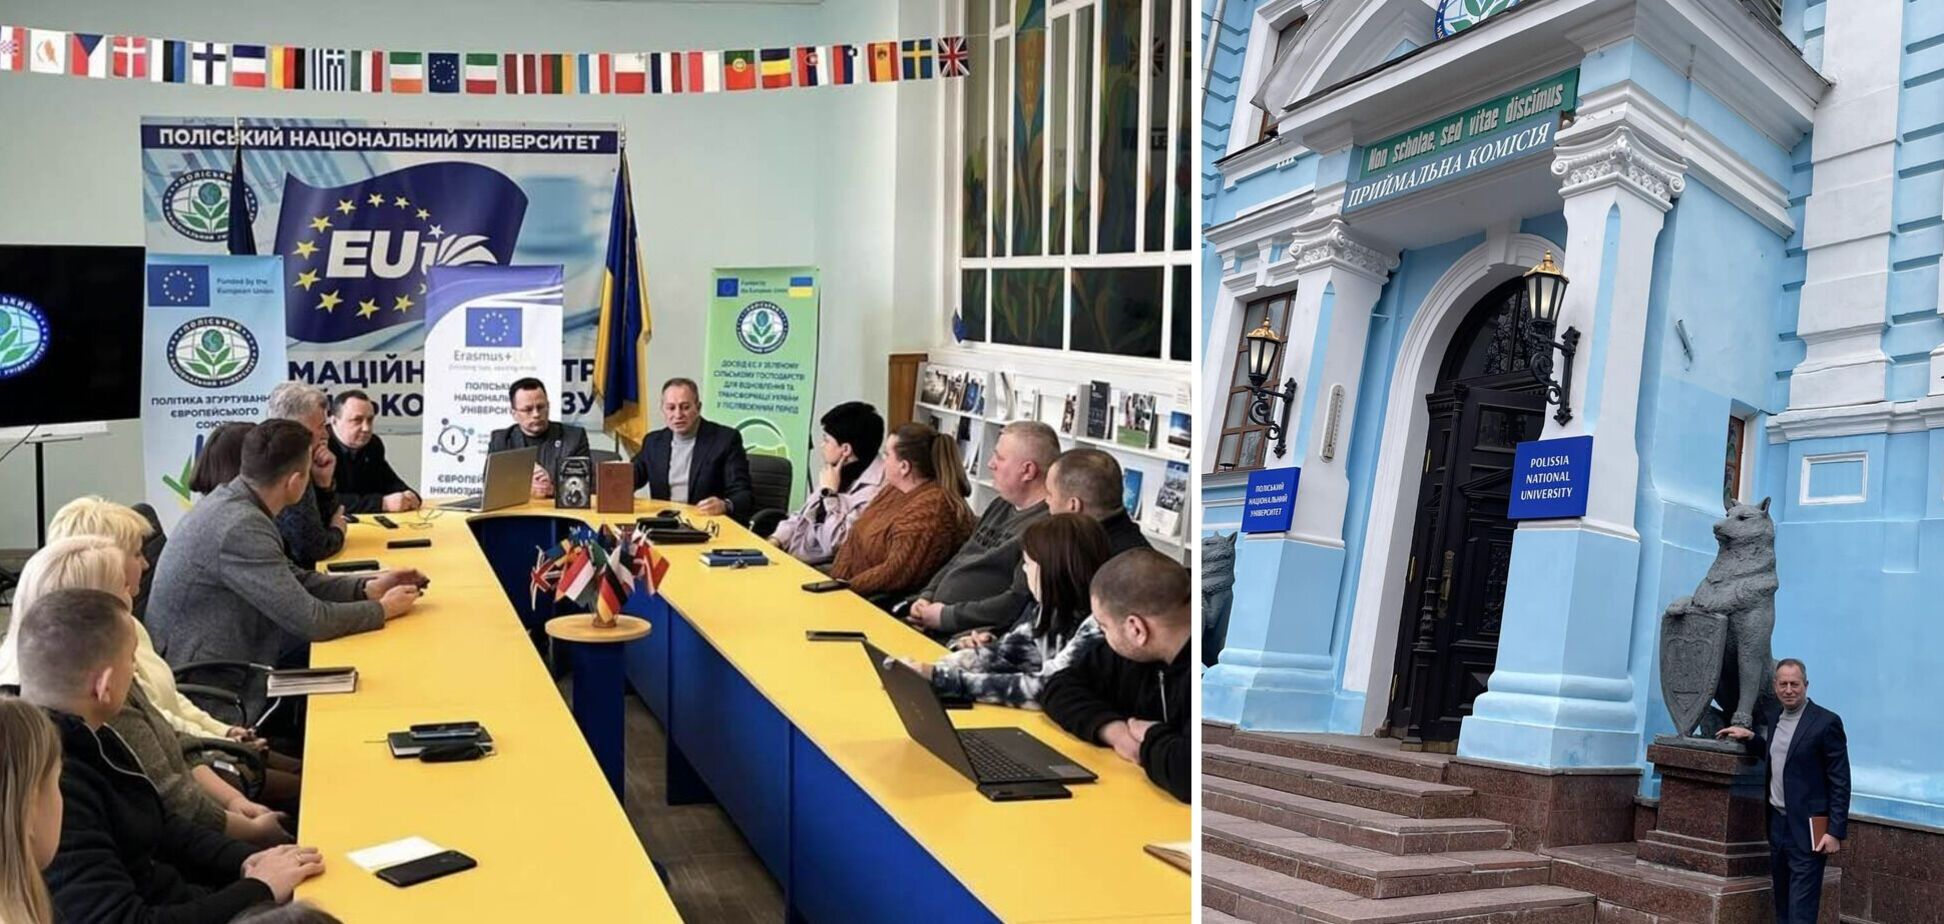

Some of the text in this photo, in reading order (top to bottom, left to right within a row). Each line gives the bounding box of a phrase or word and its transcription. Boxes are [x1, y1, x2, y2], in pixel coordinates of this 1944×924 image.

[159, 125, 601, 150] ПОЛІСЬКИЙ НАЦІОНАЛЬНИЙ УНІВЕРСИТЕТ
[1368, 148, 1388, 172] Non
[1392, 131, 1436, 163] scholae,
[1440, 117, 1463, 146] sed
[1469, 107, 1499, 137] vitae
[1347, 122, 1551, 208] ПРИЙМАЛЬНА КОМІСІЯ
[151, 396, 204, 406] ПОЛІТИКА
[170, 407, 260, 418] ЄВРОПЕЙСЬКОГО
[1530, 455, 1570, 468] POLISSIA
[1525, 471, 1571, 485] NATIONAL
[1520, 487, 1573, 501] UNIVERSITY
